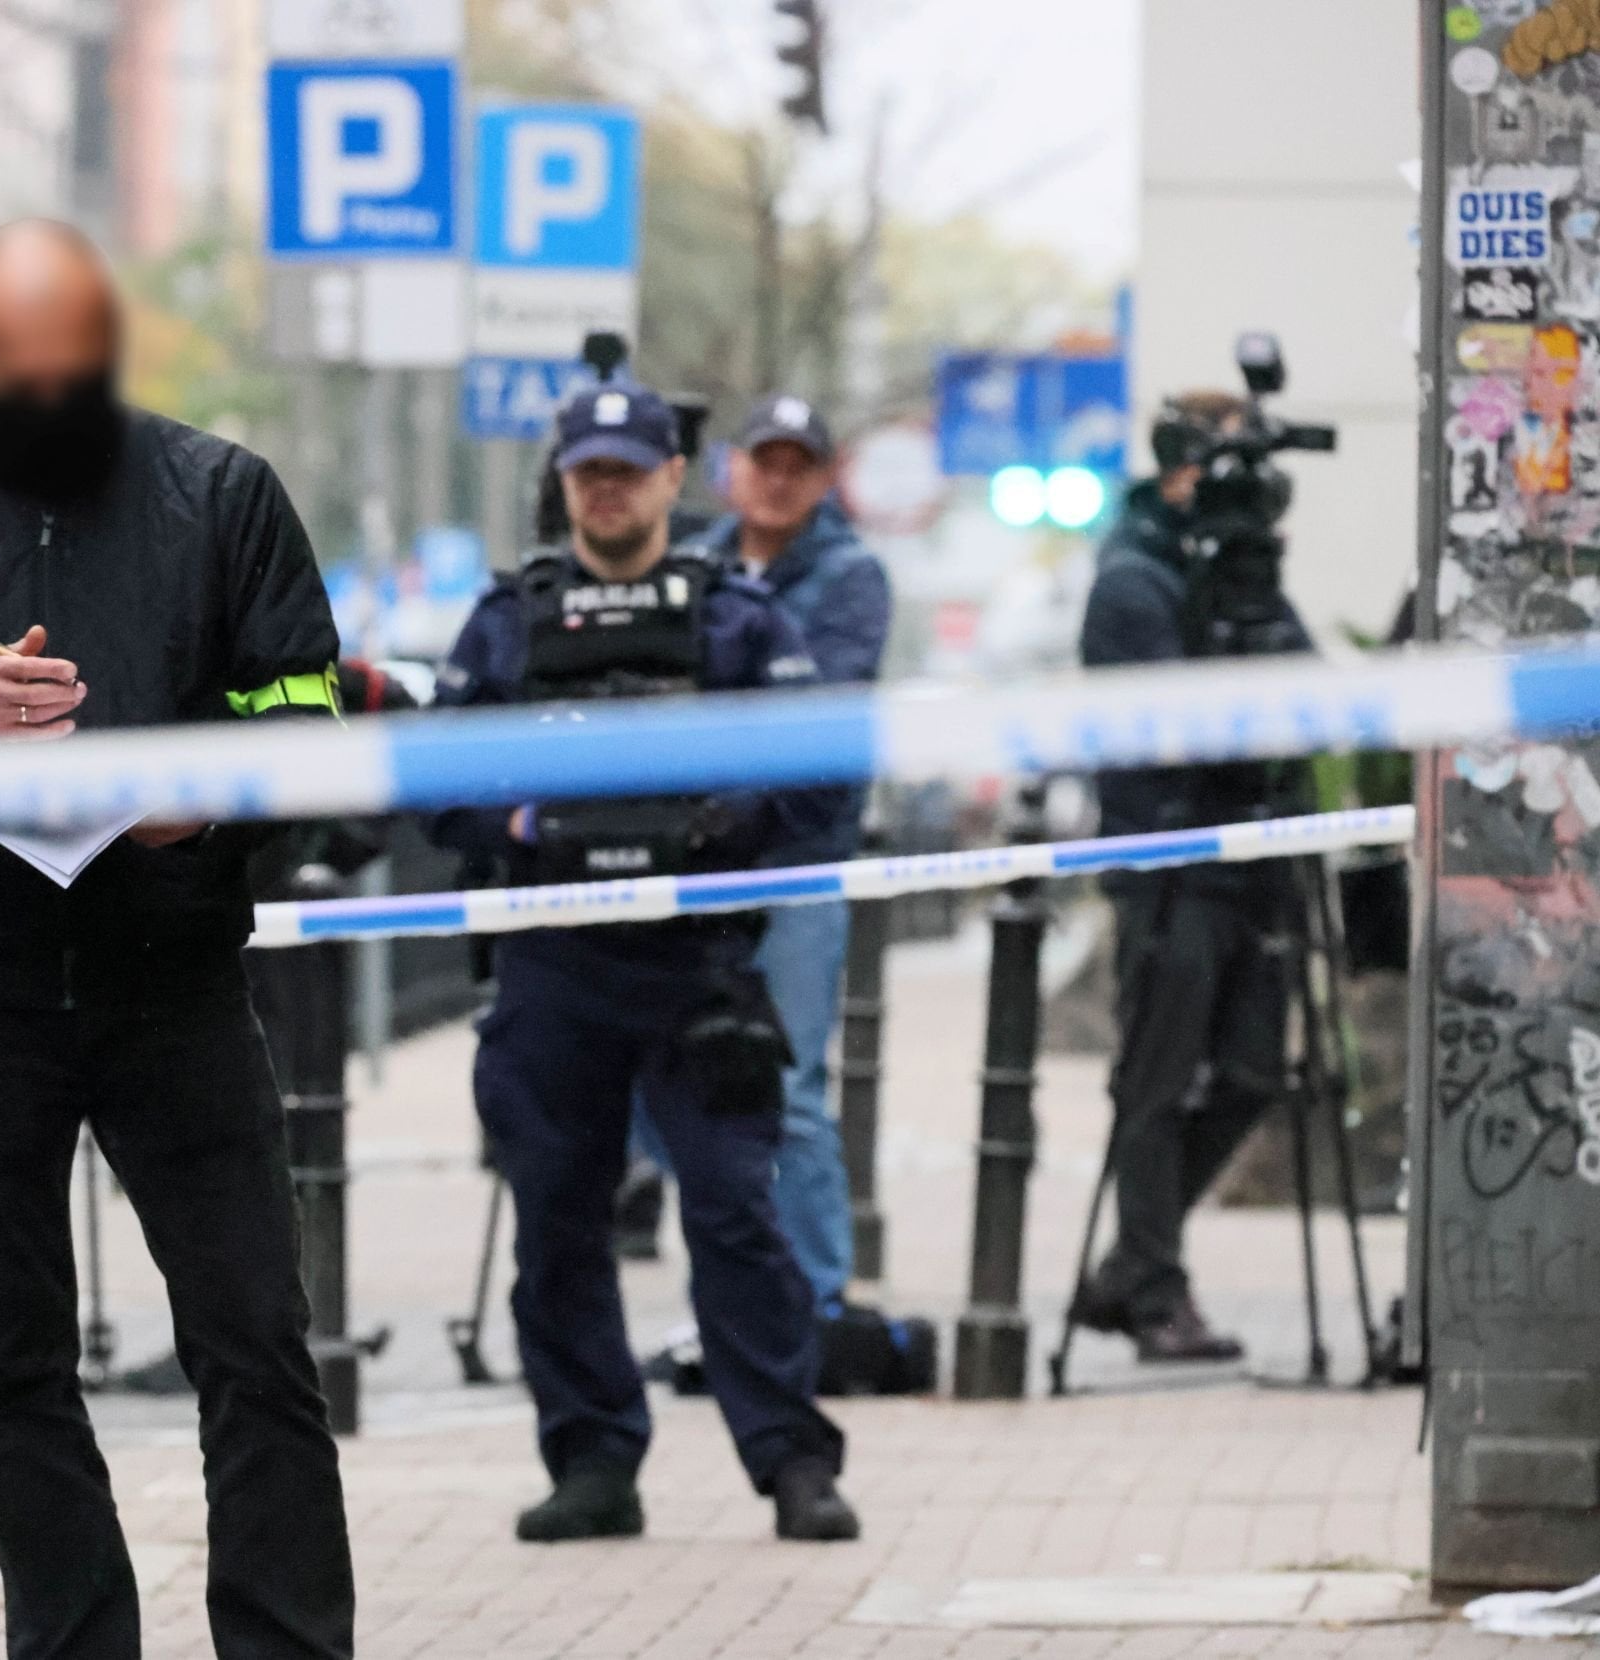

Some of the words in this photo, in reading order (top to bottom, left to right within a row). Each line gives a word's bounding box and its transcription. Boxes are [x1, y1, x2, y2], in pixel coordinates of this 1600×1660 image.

[299, 79, 423, 241] P
[506, 124, 608, 254] P
[1460, 230, 1545, 259] DIES
